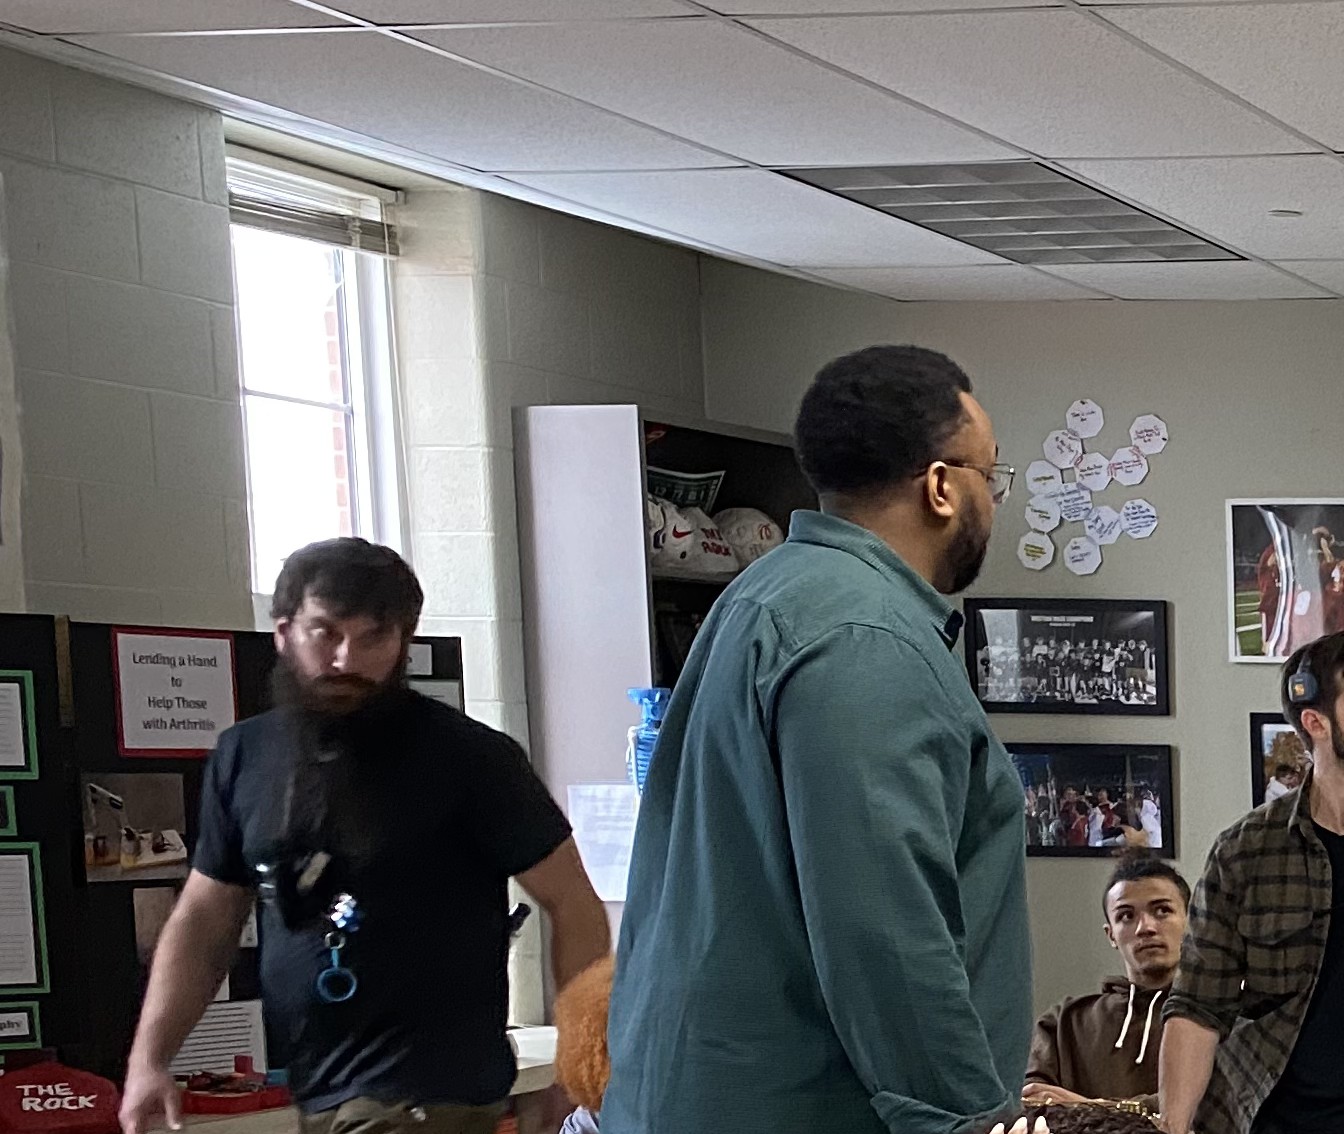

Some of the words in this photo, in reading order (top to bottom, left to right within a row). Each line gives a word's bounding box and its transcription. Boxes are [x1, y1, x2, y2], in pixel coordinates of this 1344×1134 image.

[132, 652, 177, 668] Lending
[178, 655, 186, 664] a
[187, 654, 218, 668] Hand
[171, 676, 182, 687] to
[147, 696, 174, 711] Help
[176, 696, 207, 710] Those
[142, 718, 168, 730] with
[169, 718, 216, 731] Arthritis
[15, 1082, 74, 1096] THE
[21, 1095, 98, 1112] ROCK
